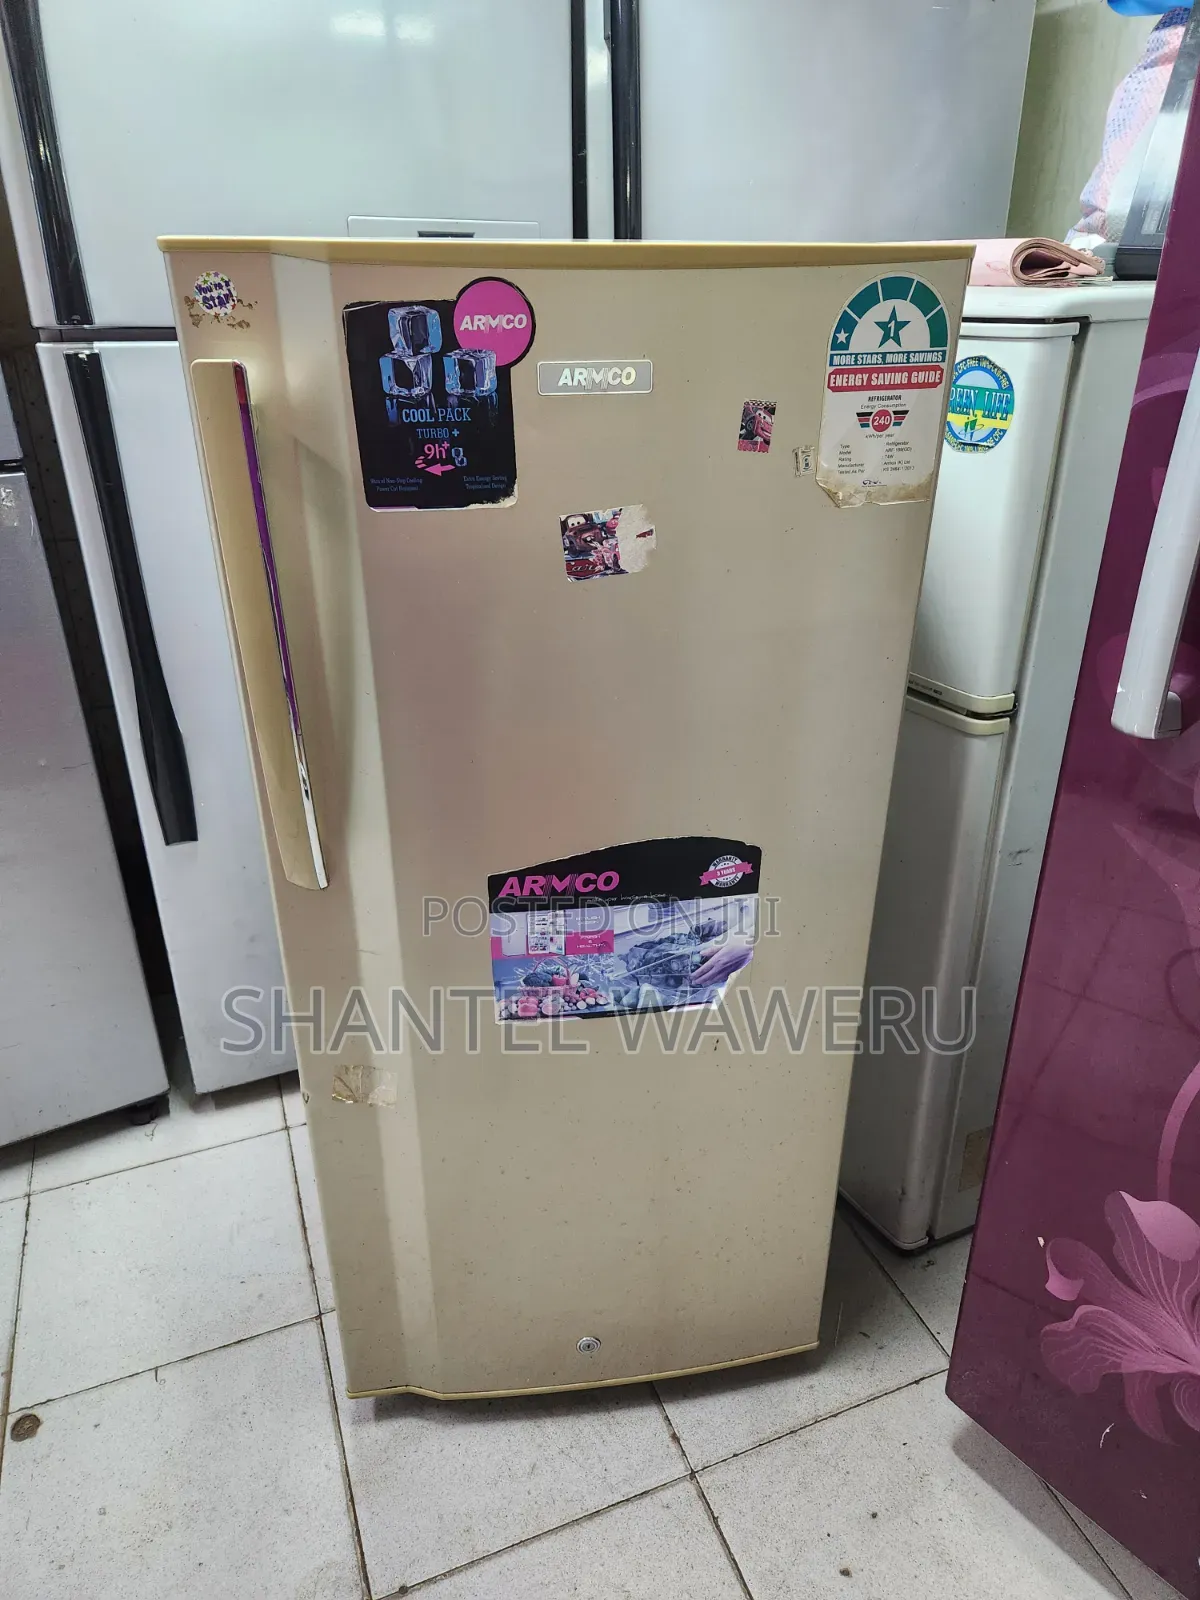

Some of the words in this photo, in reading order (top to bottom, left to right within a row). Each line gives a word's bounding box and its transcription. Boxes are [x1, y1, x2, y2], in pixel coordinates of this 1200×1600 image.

[195, 282, 224, 296] You're
[459, 313, 527, 333] ARMCO
[887, 320, 895, 338] 1
[832, 354, 855, 366] MORE
[857, 353, 884, 365] STARS,
[885, 353, 908, 363] MORE
[909, 351, 943, 363] SAVINGS
[557, 366, 637, 389] ARMCO
[829, 373, 868, 387] ENERGY
[870, 371, 908, 385] SAVING
[910, 370, 942, 384] GUIDE
[867, 394, 902, 402] REFRIGERATOR
[983, 391, 1011, 421] LIFE
[402, 408, 435, 423] COOL
[437, 407, 472, 422] PACK
[873, 415, 892, 426] 240
[416, 427, 449, 439] TURBO
[498, 871, 620, 897] ARMCO
